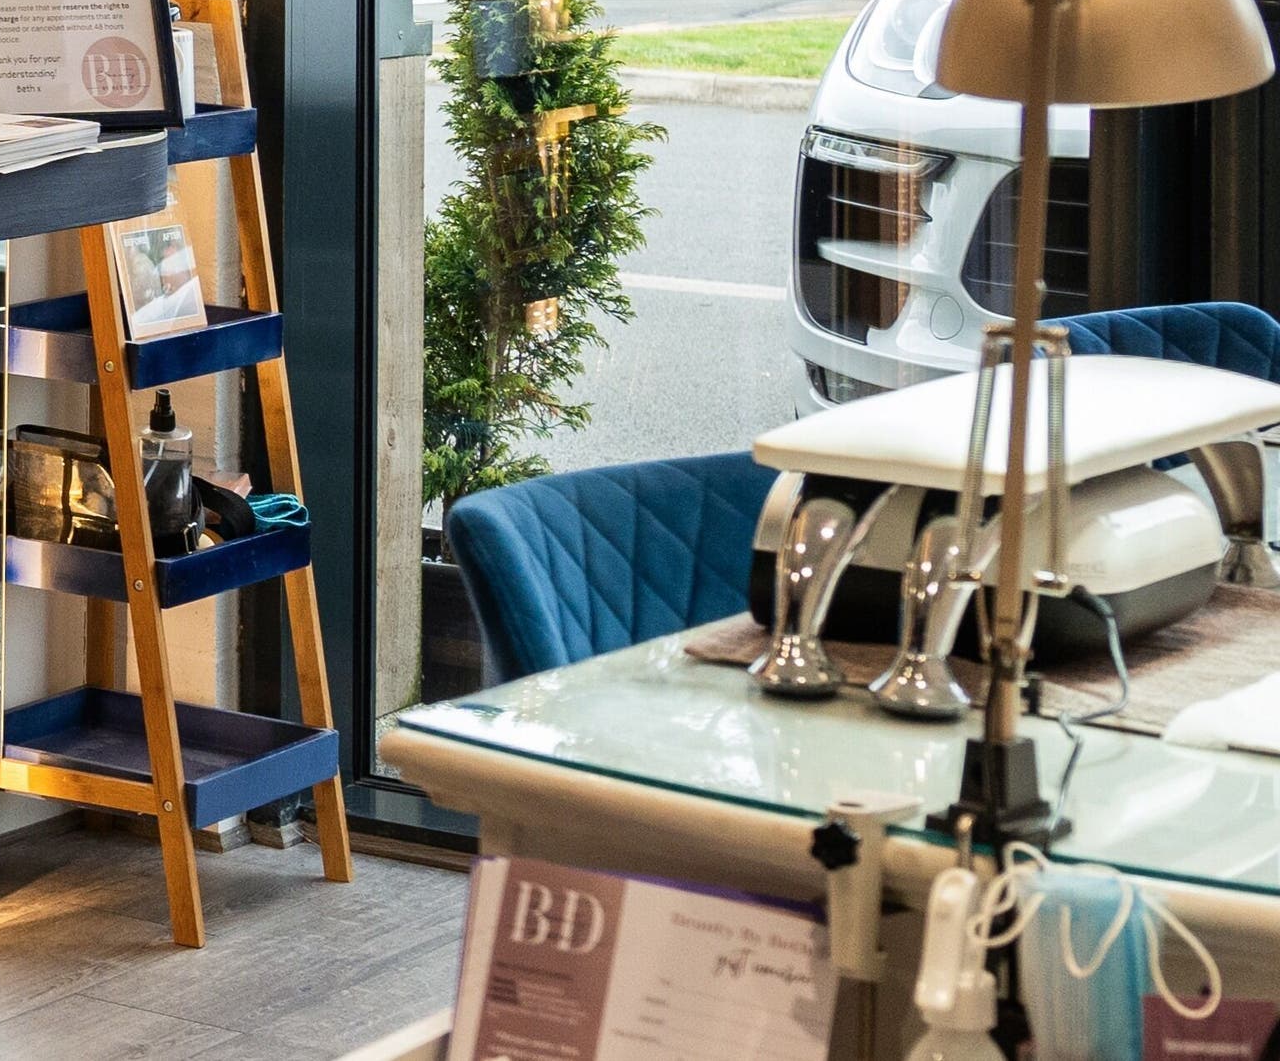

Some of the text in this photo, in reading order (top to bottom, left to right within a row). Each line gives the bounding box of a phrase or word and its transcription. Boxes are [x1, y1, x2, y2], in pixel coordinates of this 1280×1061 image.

[103, 3, 120, 11] right
[13, 57, 28, 66] you
[29, 55, 41, 63] for
[43, 55, 61, 65] your
[17, 85, 35, 93] Beth
[510, 880, 605, 954] BD
